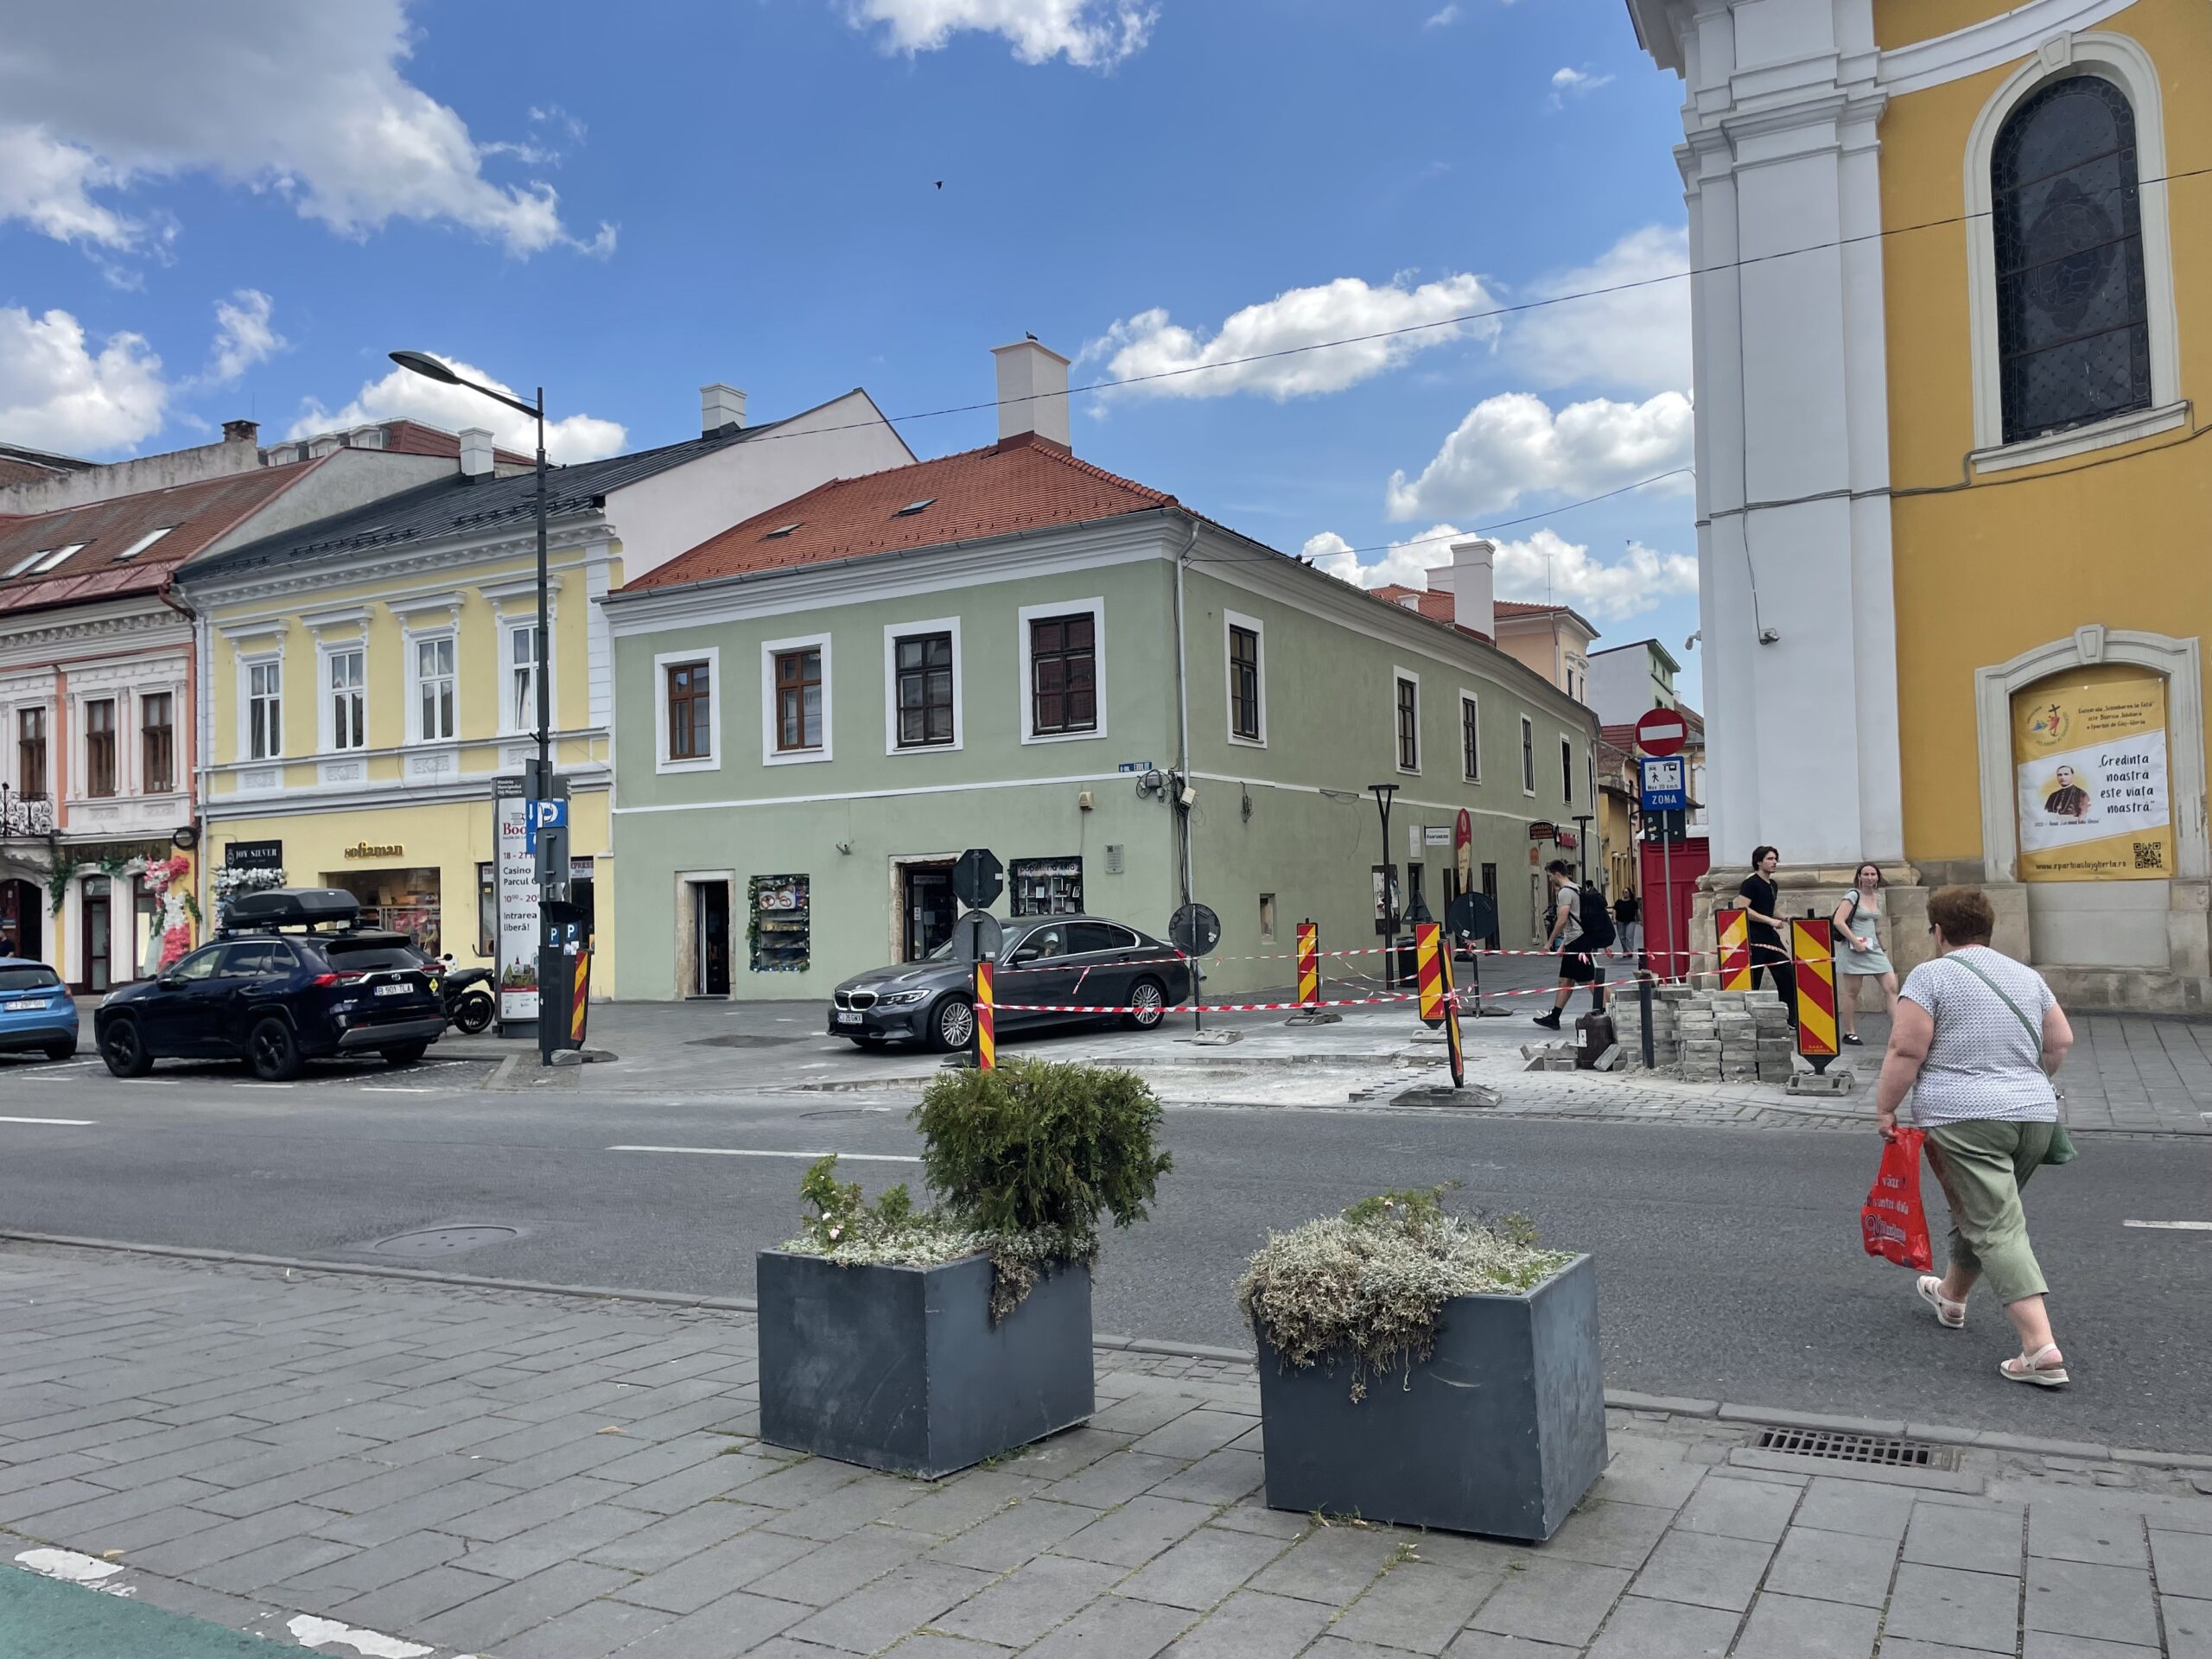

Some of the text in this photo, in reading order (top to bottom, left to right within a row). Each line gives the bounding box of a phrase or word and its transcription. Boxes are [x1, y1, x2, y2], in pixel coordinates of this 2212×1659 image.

[2106, 769, 2150, 782] noastră
[2100, 787, 2122, 798] este
[1651, 794, 1677, 805] ZONA
[236, 848, 277, 860] JOY SILVER
[503, 866, 531, 874] Casino
[503, 877, 530, 886] Parcul
[503, 912, 537, 920] Intrarea
[503, 922, 531, 932] liberă!
[567, 923, 575, 938] P
[550, 926, 558, 941] P
